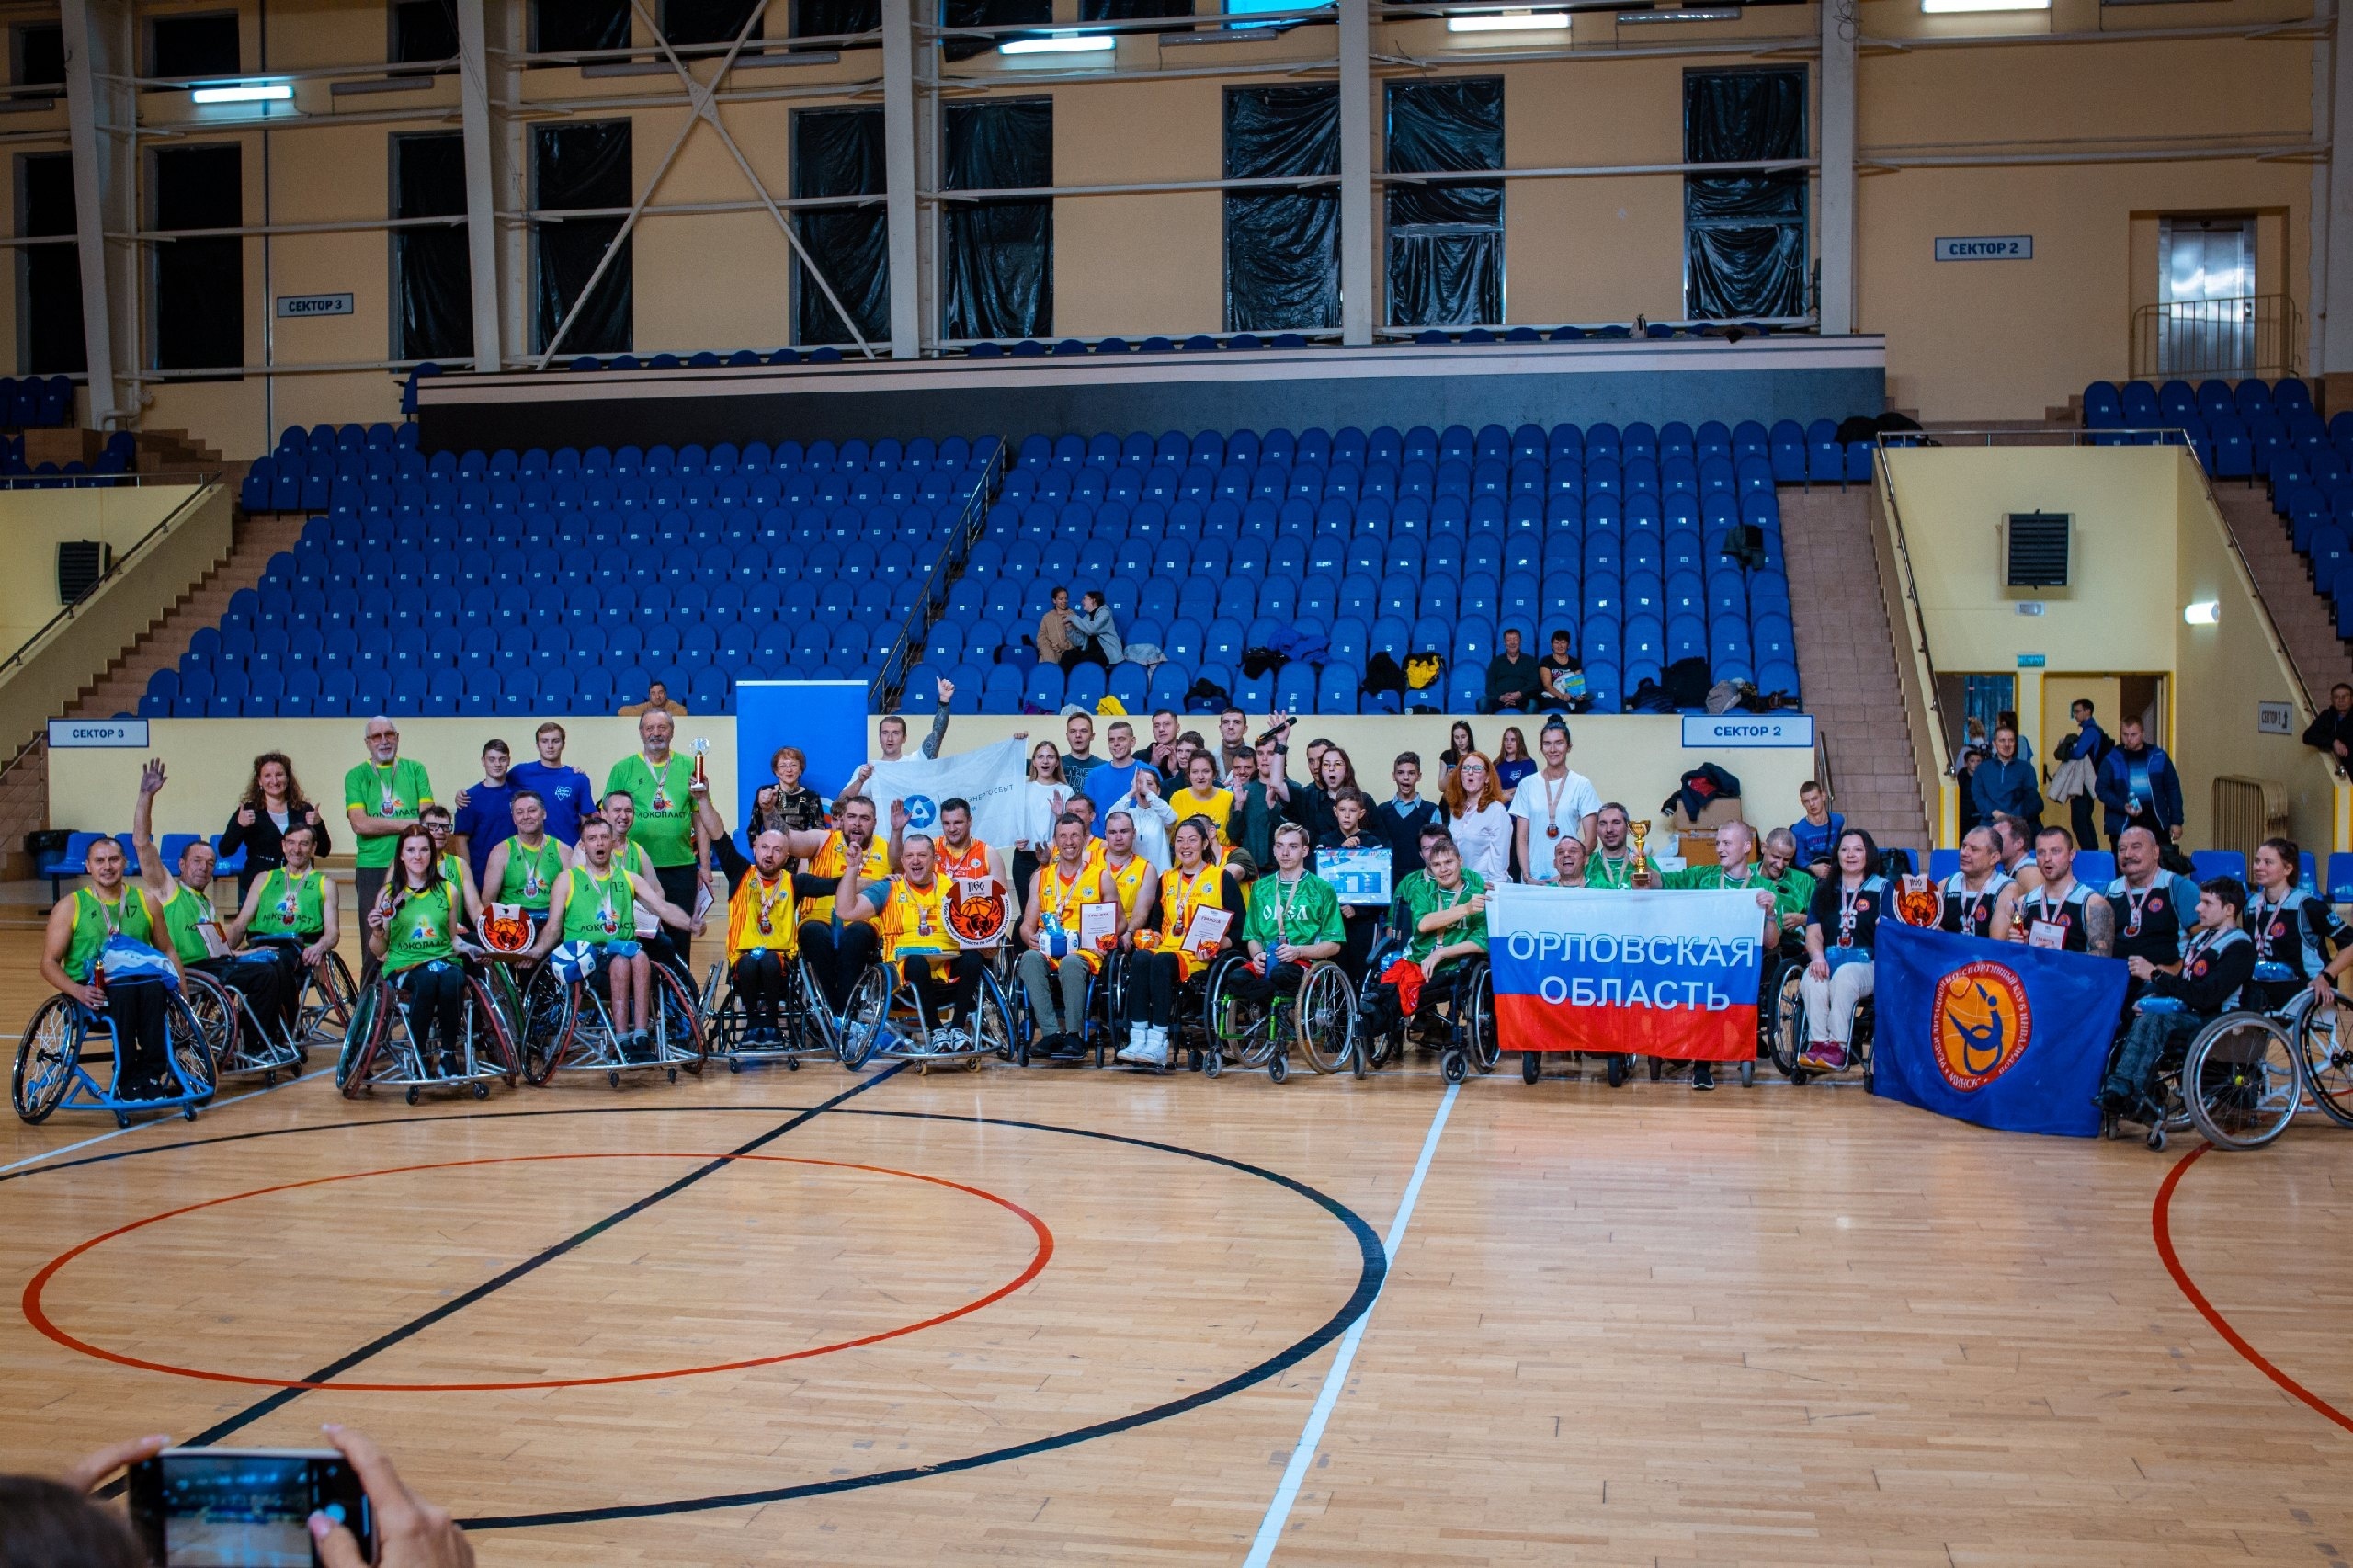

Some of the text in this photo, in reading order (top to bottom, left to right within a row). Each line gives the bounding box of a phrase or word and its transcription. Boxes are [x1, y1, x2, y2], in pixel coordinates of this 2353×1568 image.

[1949, 243, 2018, 255] СЕКТОР 2
[289, 300, 342, 312] СЕКТОР 3
[73, 729, 124, 738] СЕКТОР 3
[1713, 726, 1781, 736] СЕКТОР 2
[548, 852, 555, 862] 5
[447, 869, 454, 879] 8
[303, 880, 314, 890] 12
[611, 882, 624, 892] 13
[437, 898, 444, 909] 2
[125, 905, 137, 918] 17
[1916, 919, 1923, 927] 3
[974, 930, 982, 939] 1
[504, 942, 511, 951] 2
[1507, 930, 1755, 967] ОРЛОВСКАЯ
[1540, 975, 1731, 1012] ОБЛАСТЬ
[1948, 1072, 1978, 1089] МИНСК
